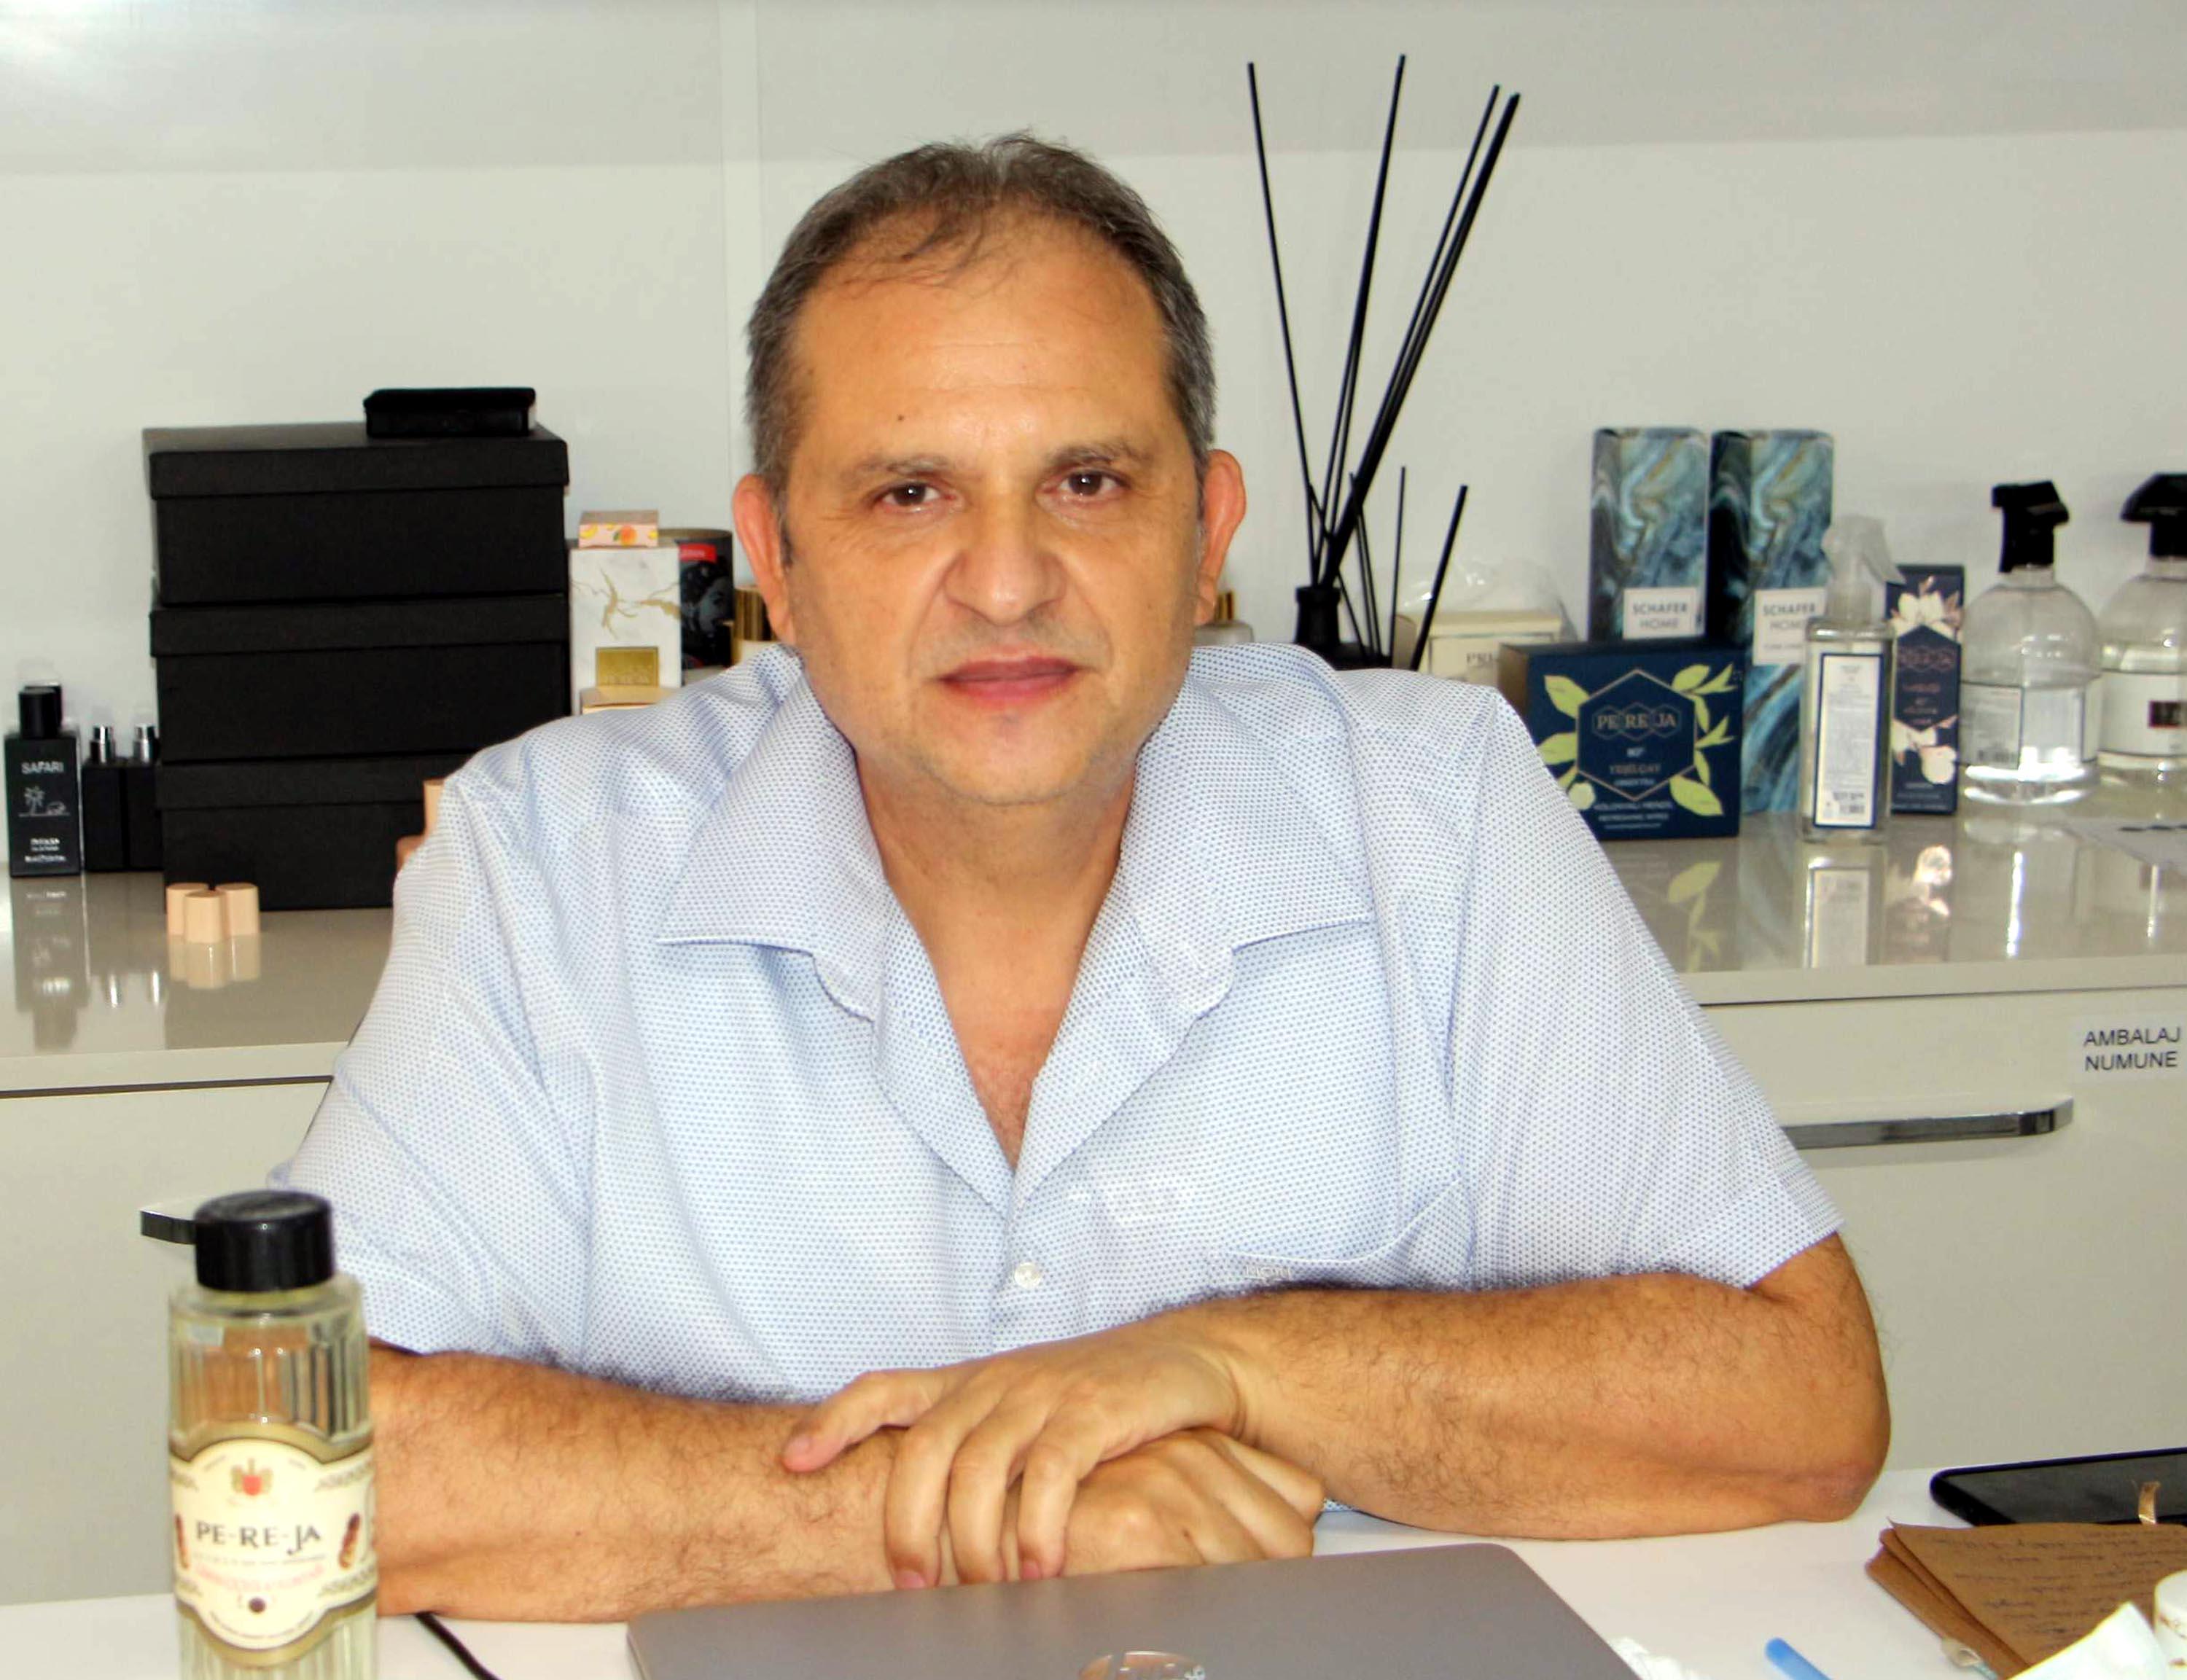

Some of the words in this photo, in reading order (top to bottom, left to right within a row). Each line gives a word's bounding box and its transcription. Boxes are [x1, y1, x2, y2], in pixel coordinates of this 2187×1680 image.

[1633, 603, 1688, 615] SCHAFER
[1763, 603, 1815, 617] SCHAFER
[21, 762, 64, 775] SAFARI
[2084, 1027, 2181, 1047] AMBALAJ
[2085, 1050, 2178, 1071] NUMUNE
